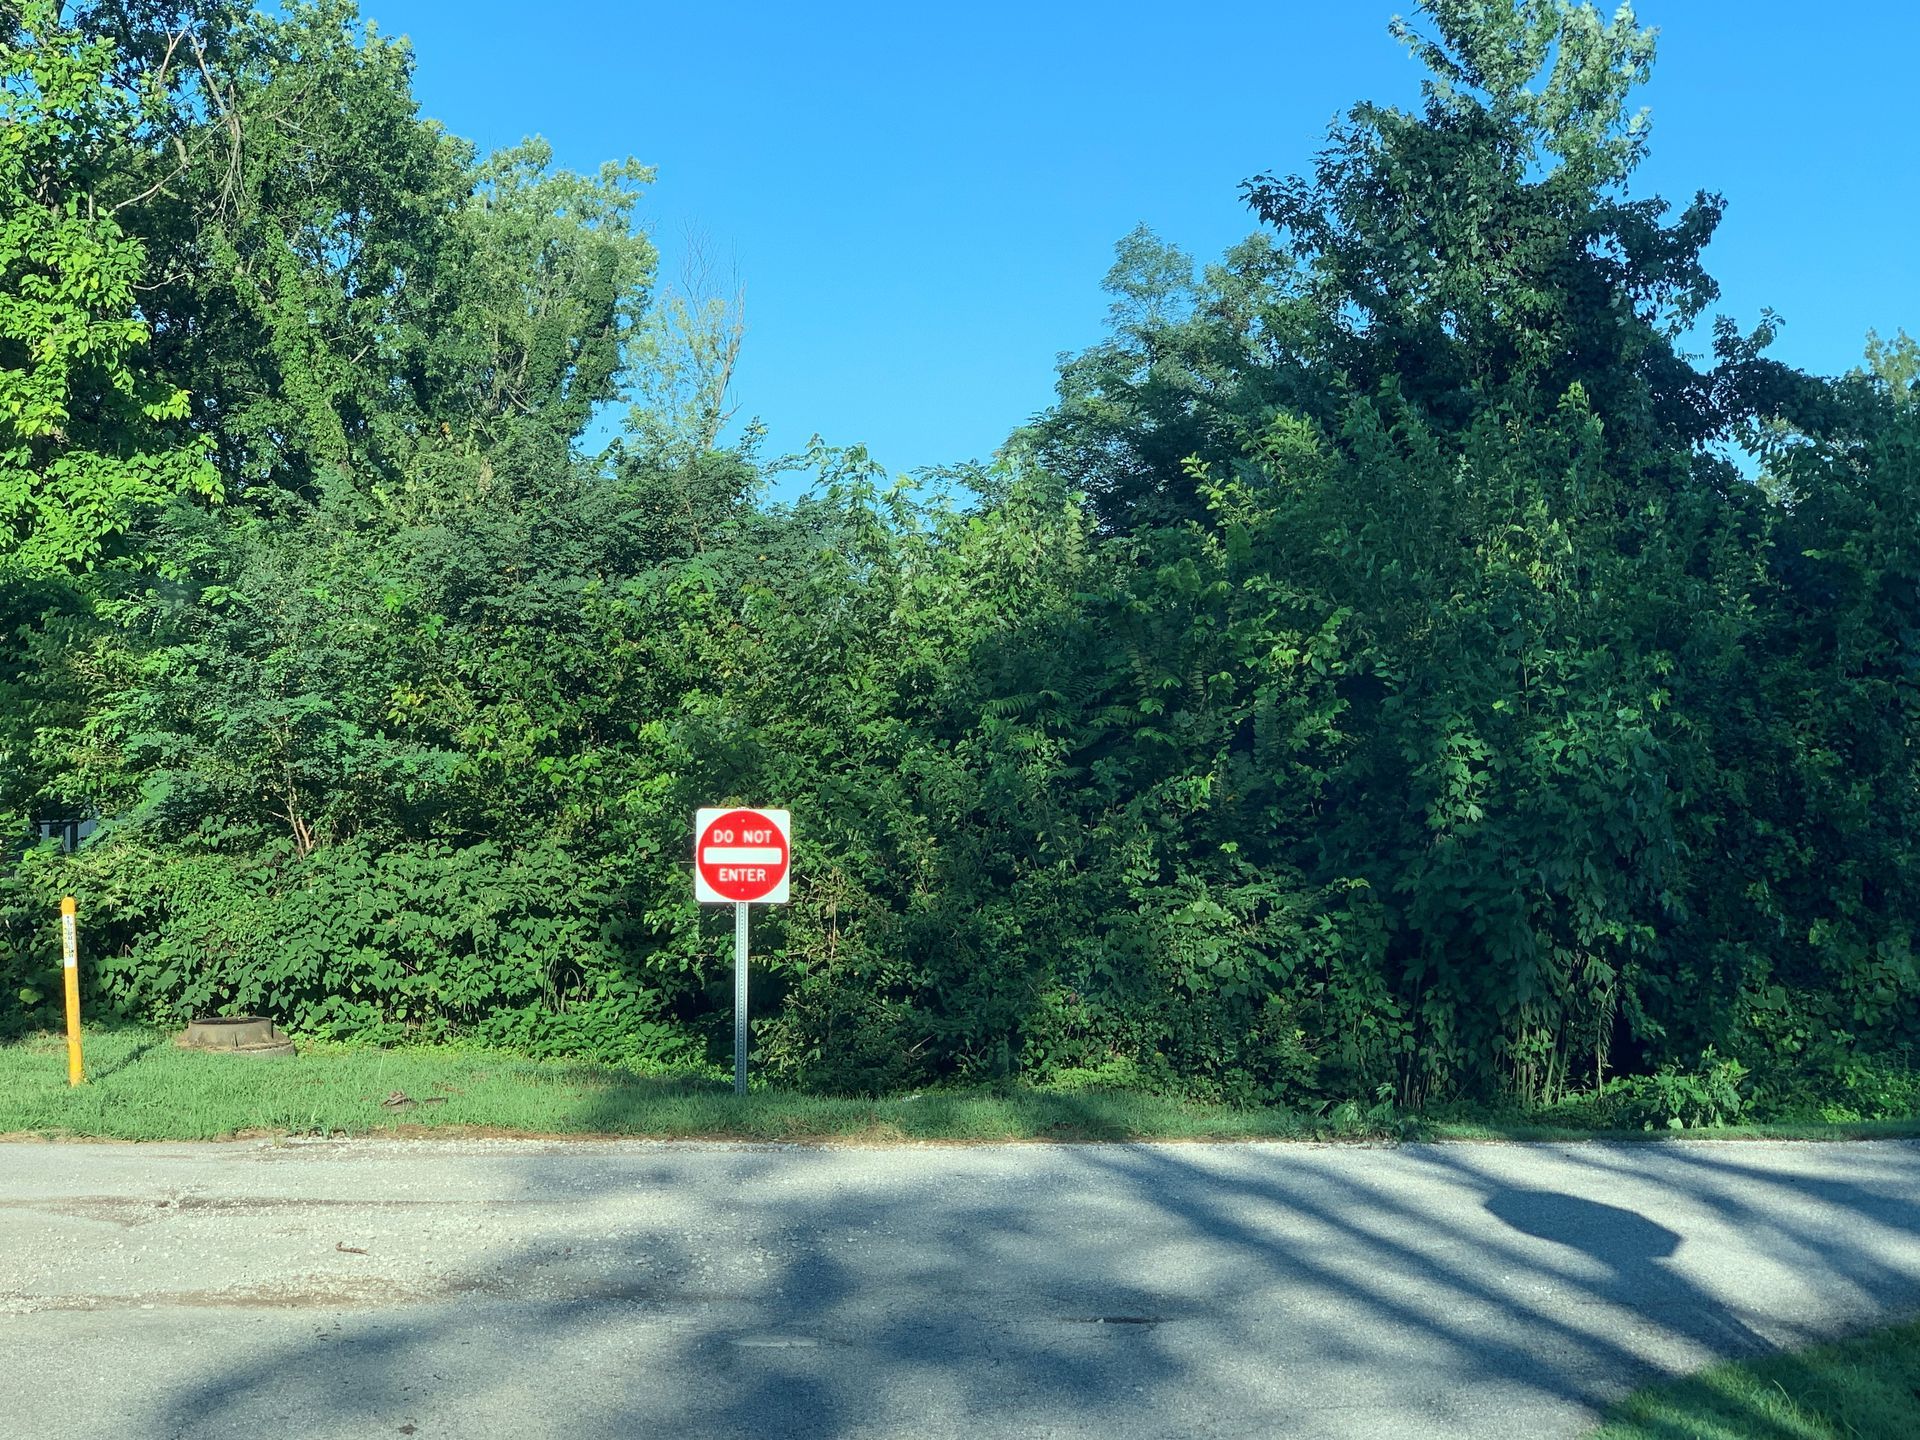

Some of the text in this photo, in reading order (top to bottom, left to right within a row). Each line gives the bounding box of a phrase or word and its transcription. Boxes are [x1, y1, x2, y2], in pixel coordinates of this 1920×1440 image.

[713, 829, 773, 844] DO NOT
[719, 868, 766, 882] ENTER
